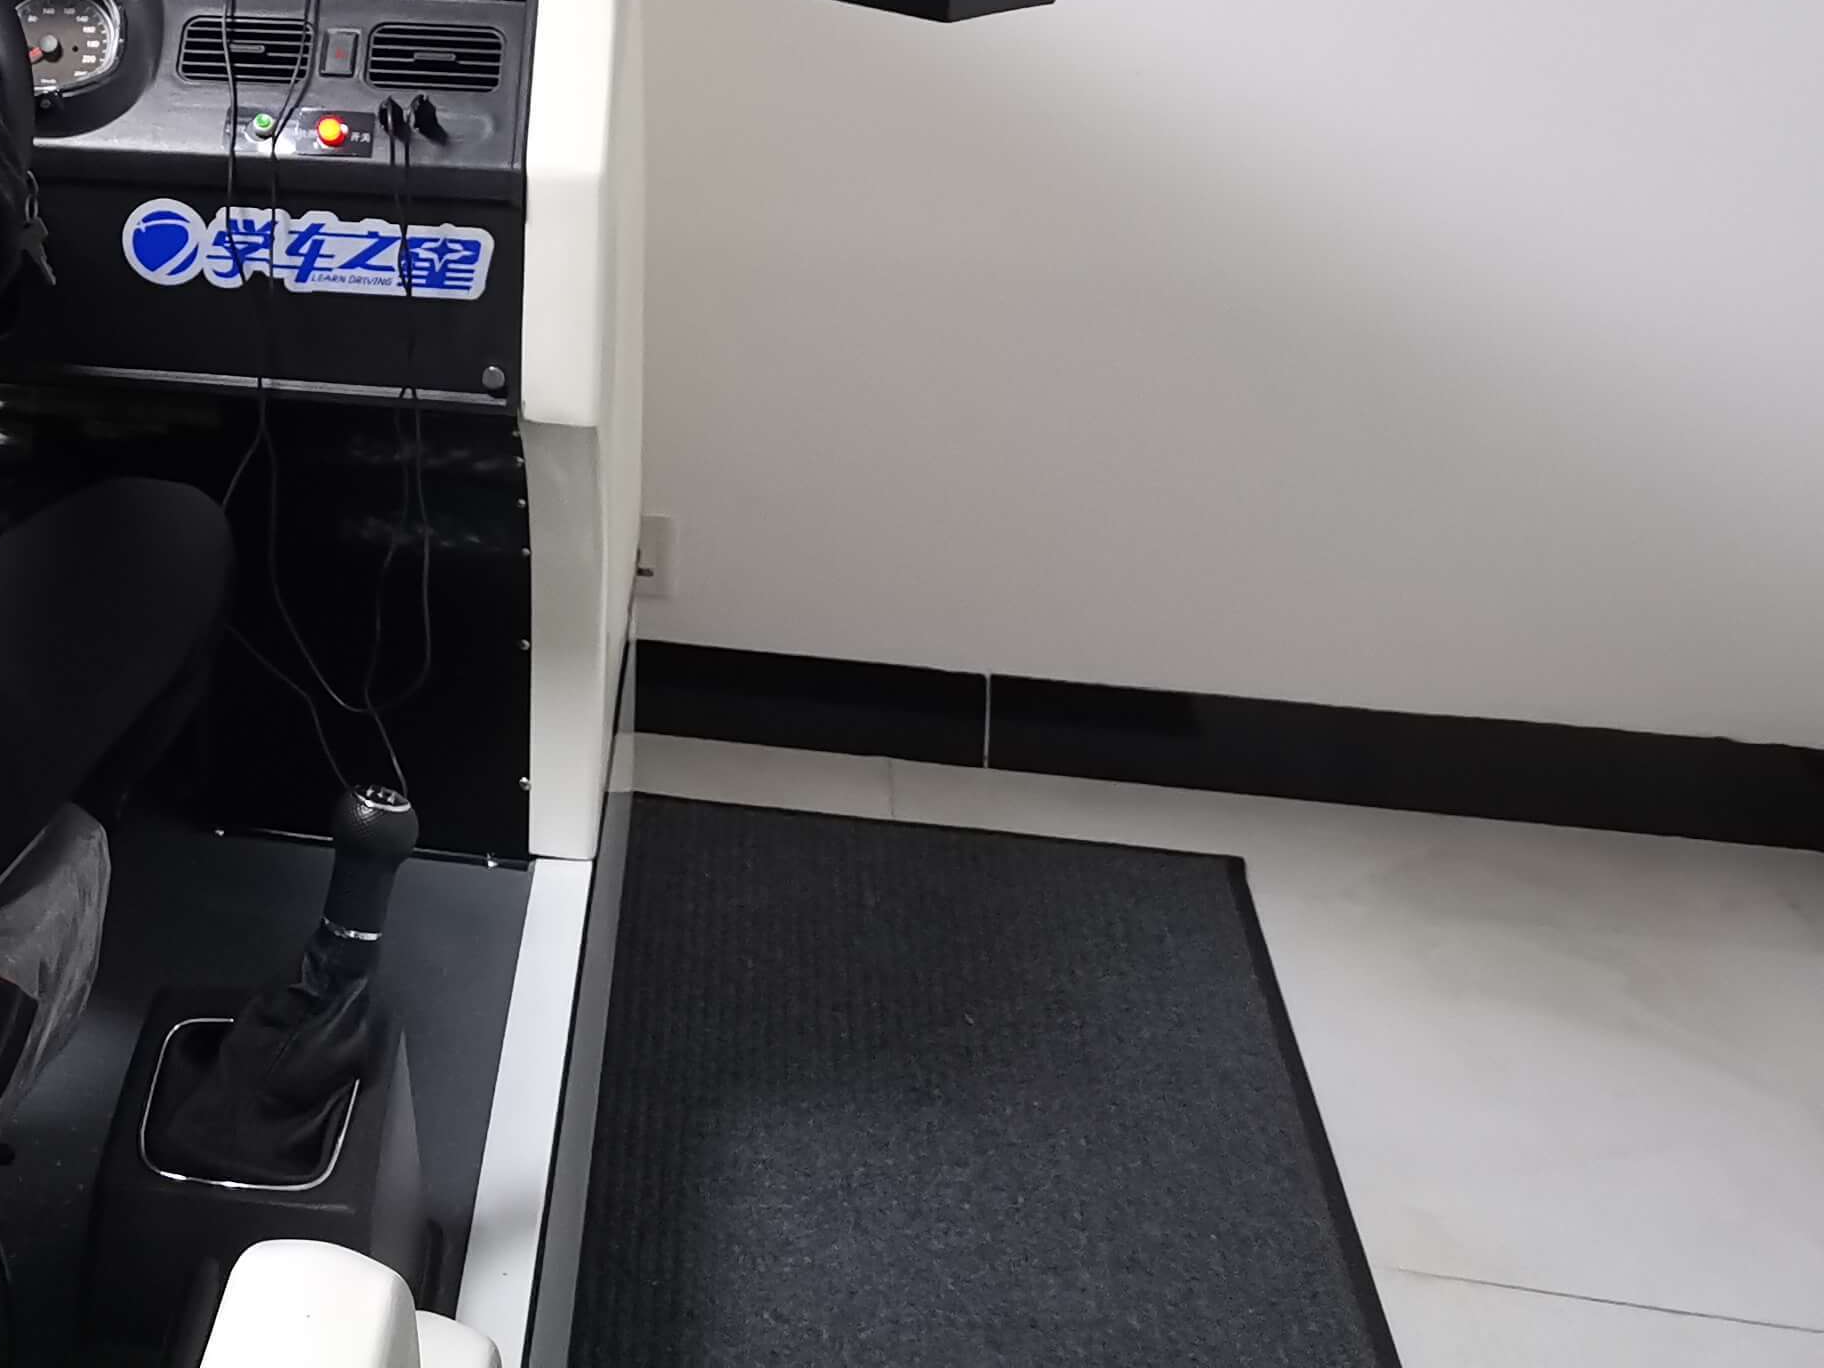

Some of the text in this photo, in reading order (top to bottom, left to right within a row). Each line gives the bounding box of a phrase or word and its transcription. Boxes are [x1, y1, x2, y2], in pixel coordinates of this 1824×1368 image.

[206, 219, 482, 292] 学车之星
[311, 274, 393, 287] LEARN DRIVING
